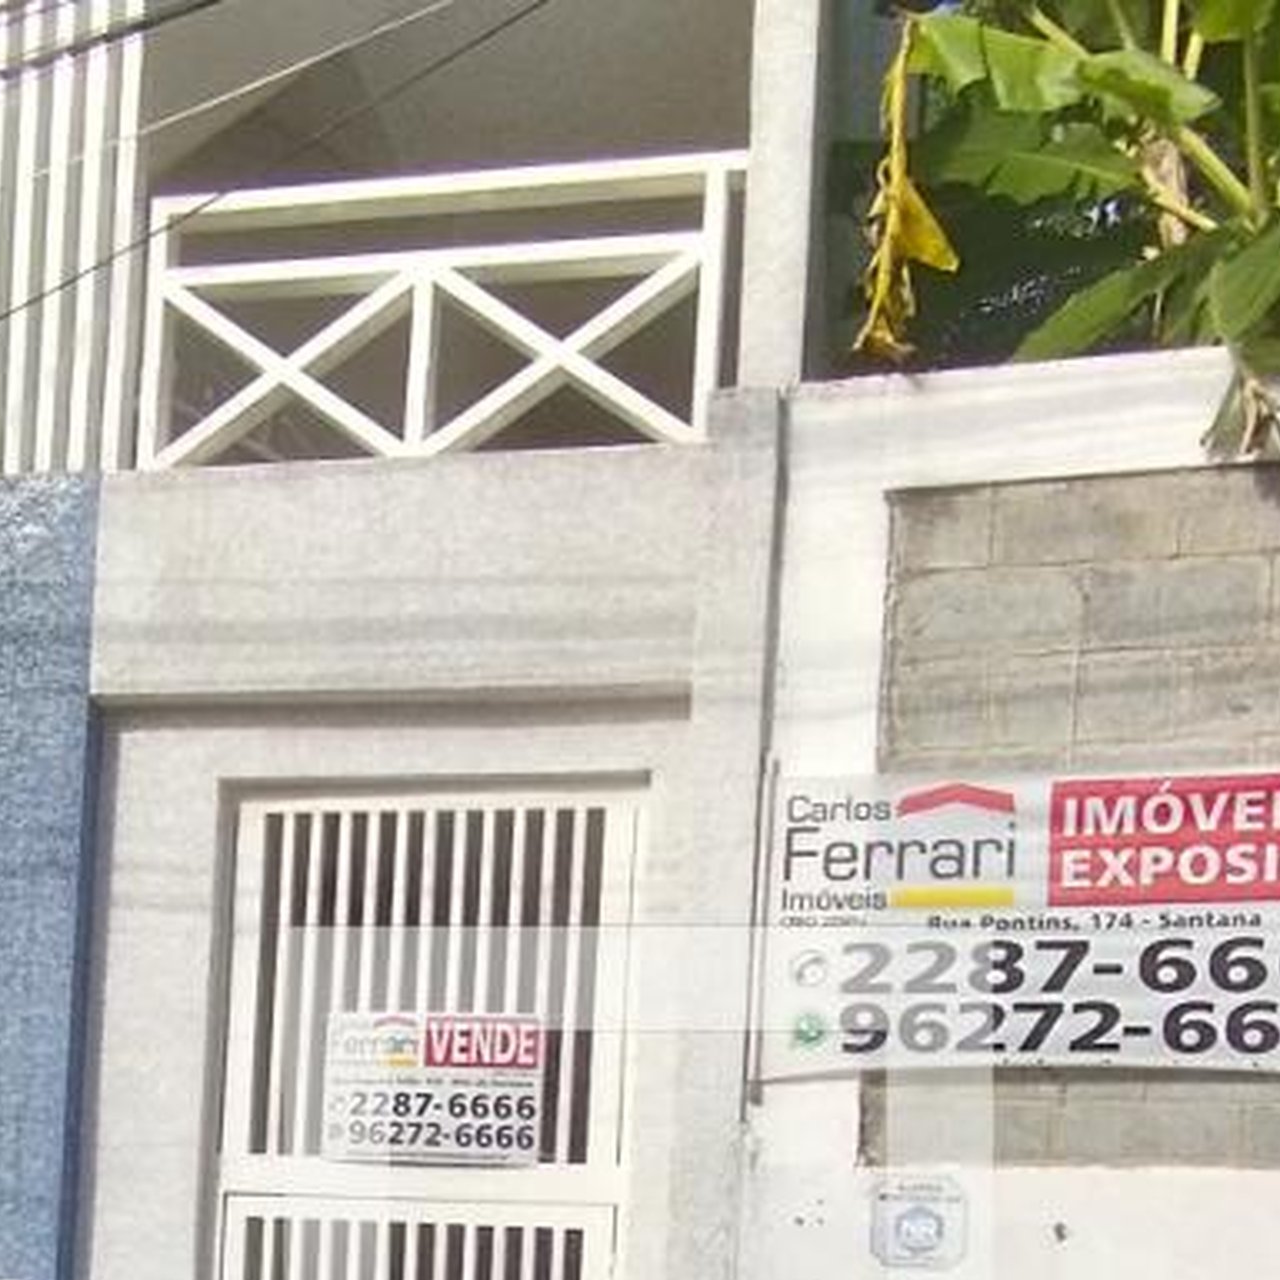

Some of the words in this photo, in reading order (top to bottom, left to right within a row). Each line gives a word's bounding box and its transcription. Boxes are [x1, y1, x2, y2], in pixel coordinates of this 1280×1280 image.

[786, 795, 891, 823] Carlos
[783, 822, 1016, 881] Ferrari
[781, 888, 887, 910] Imóveis
[927, 916, 971, 929] Rua
[979, 914, 1080, 932] Pontins,
[1091, 913, 1134, 930] 174
[1158, 912, 1262, 929] Santana
[428, 1020, 535, 1065] VENDE
[349, 1092, 537, 1121] 2287-6666
[348, 1121, 536, 1150] 96272-6666
